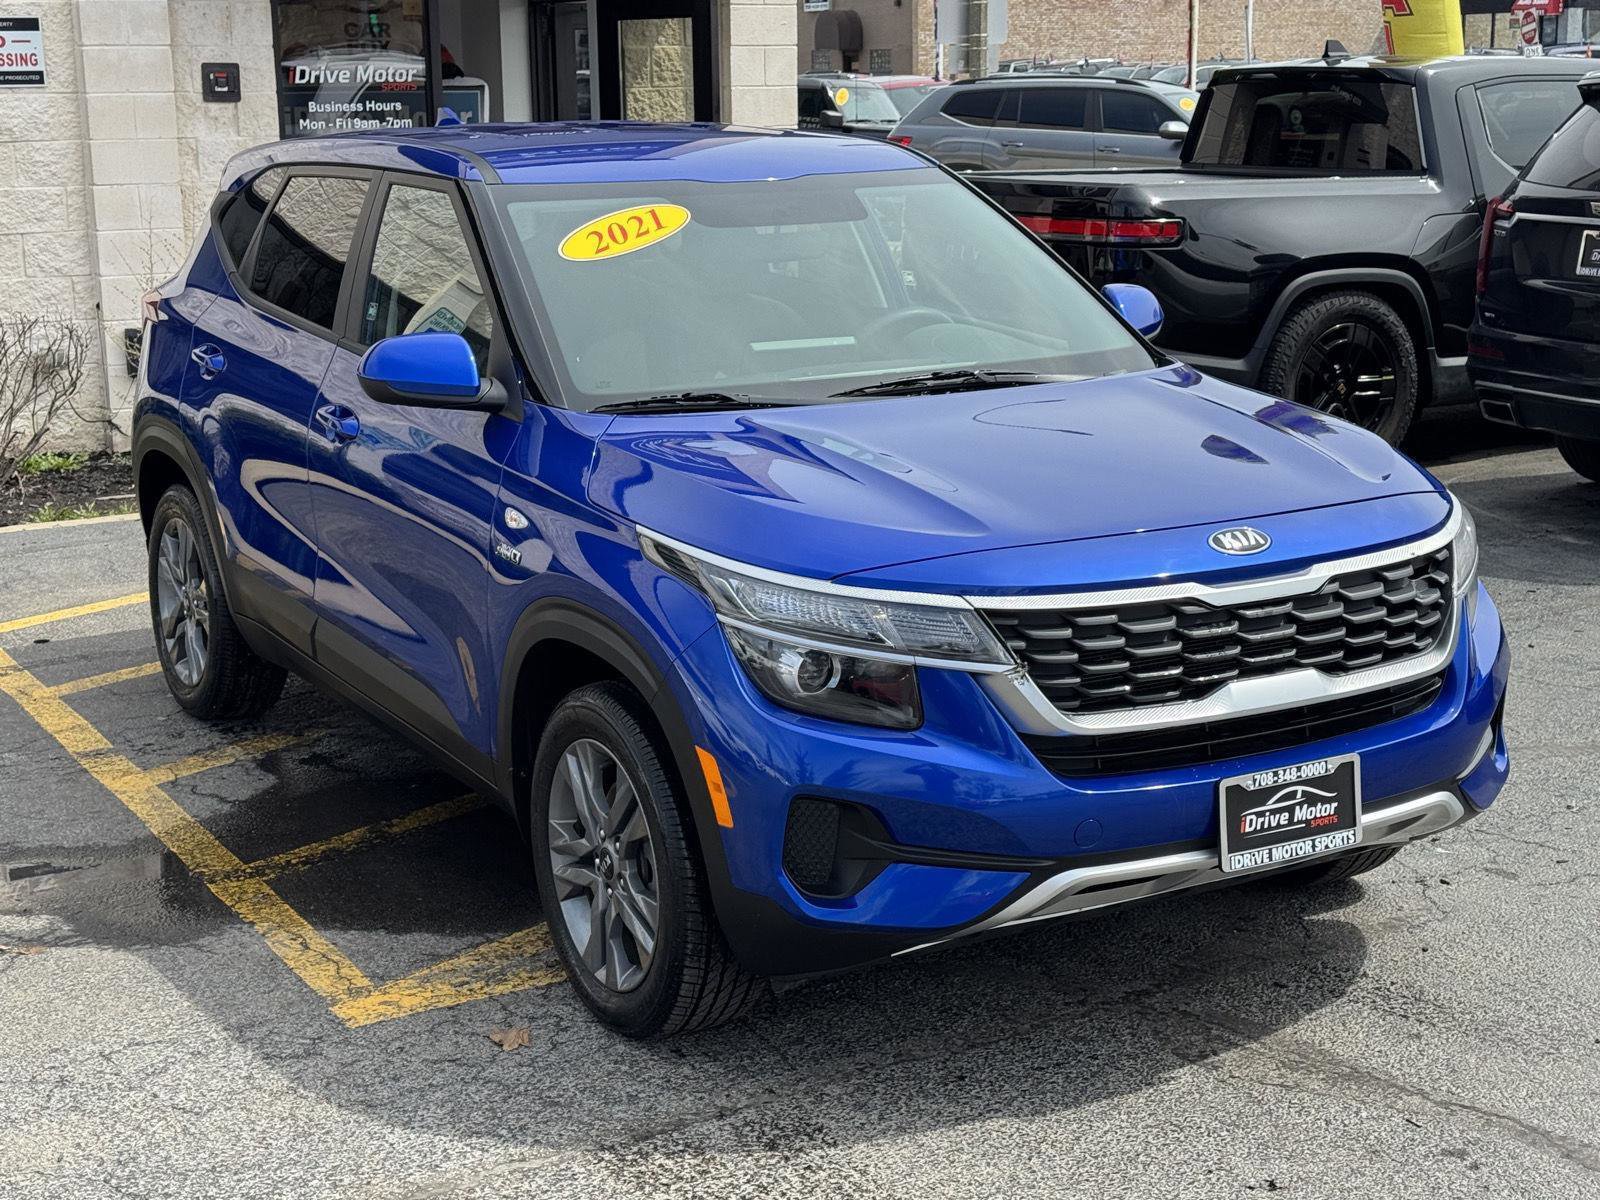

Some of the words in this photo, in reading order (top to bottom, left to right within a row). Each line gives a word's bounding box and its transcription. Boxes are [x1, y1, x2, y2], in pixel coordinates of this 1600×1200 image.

[288, 66, 351, 85] iDrive
[356, 65, 417, 83] Motor
[381, 82, 417, 91] SPORTS
[308, 101, 363, 113] Business
[366, 100, 402, 111] Hours
[299, 119, 326, 130] Mon
[354, 118, 379, 129] 9am
[586, 208, 665, 255] 2021
[1217, 530, 1265, 549] KIA
[1254, 761, 1326, 788] 708-348-0000
[1240, 813, 1290, 834] iDrive
[1293, 802, 1338, 823] Motor
[1311, 815, 1338, 828] SPORTS
[1272, 840, 1313, 861] MOTOR
[1314, 830, 1355, 852] SPORTS
